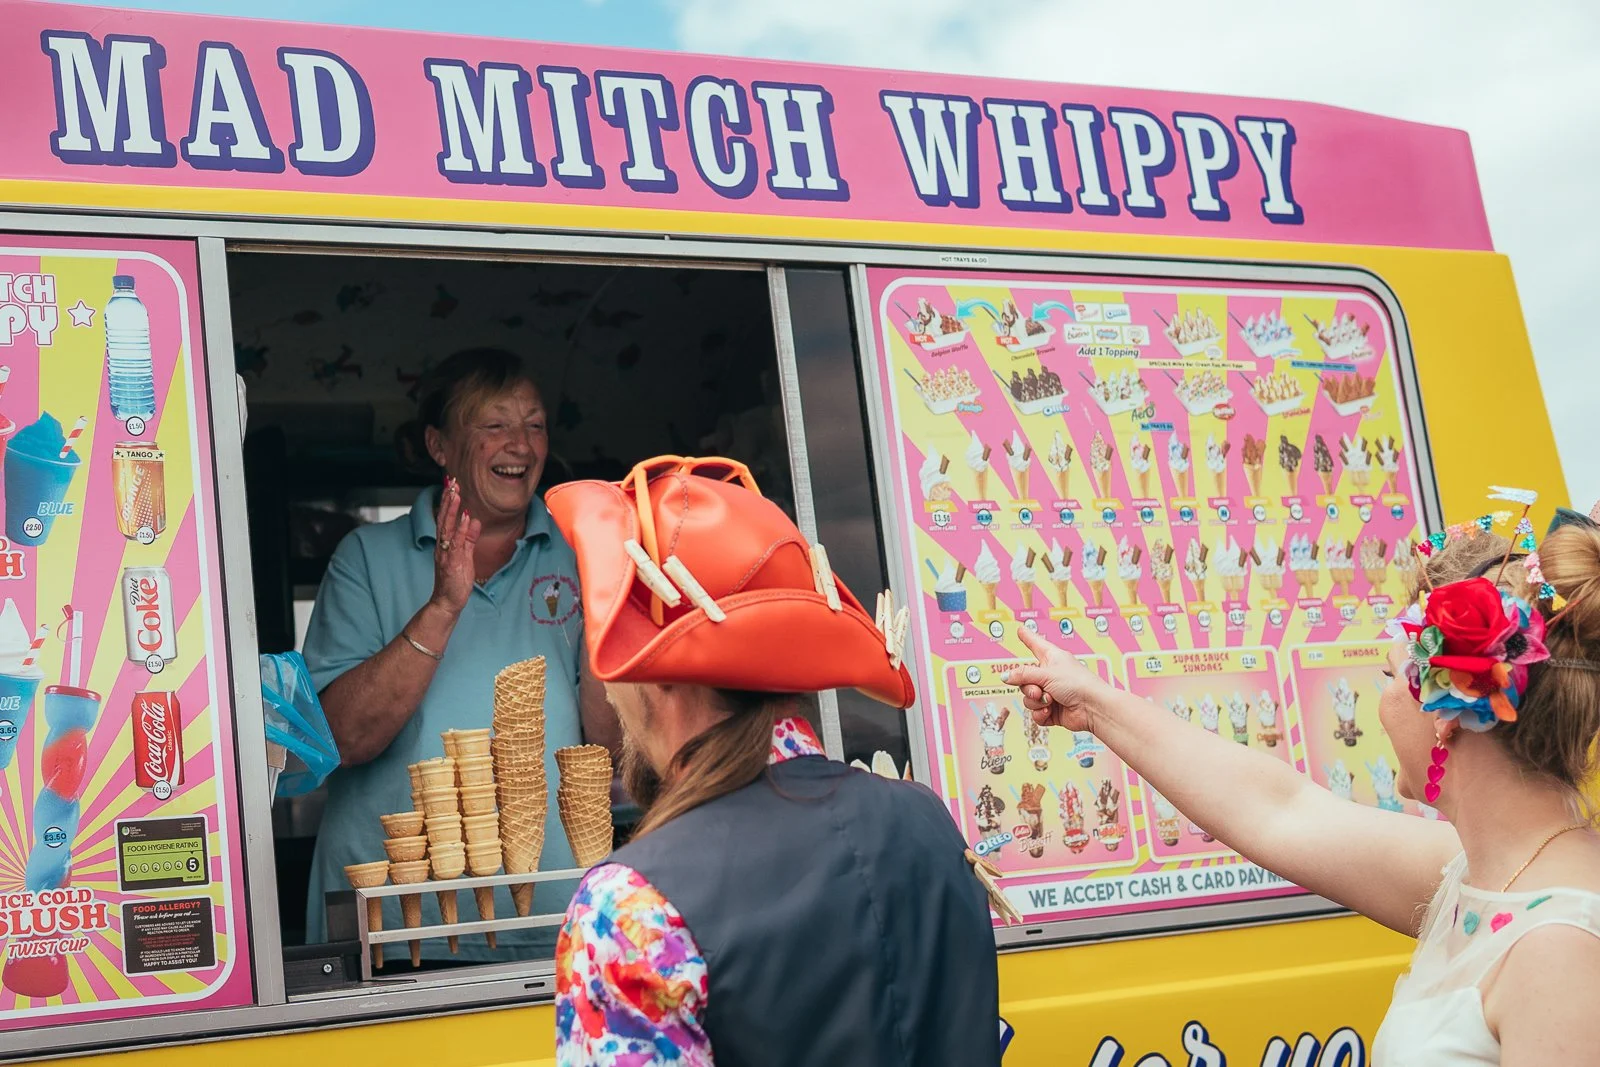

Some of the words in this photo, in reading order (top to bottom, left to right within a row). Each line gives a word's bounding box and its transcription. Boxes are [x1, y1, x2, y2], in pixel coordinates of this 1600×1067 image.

[41, 31, 374, 175] MAD
[425, 58, 849, 200] MITCH
[881, 90, 1303, 224] WHIPPY
[1078, 347, 1097, 356] Add
[1105, 347, 1139, 358] Topping
[129, 422, 142, 430] £1.50
[122, 465, 146, 521] ORANGE
[38, 502, 74, 516] BLUE
[25, 523, 42, 532] £2.50
[139, 531, 152, 539] £1.50
[130, 578, 140, 606] Diet
[136, 576, 163, 652] Coke
[1173, 654, 1200, 664] SUPER
[1202, 653, 1230, 662] SAUCE
[1342, 648, 1379, 657] SUNDAES
[148, 660, 162, 668] £1.50
[1183, 663, 1223, 673] SUNDAES
[980, 754, 1012, 769] bueno
[155, 786, 170, 794] £1.50
[44, 833, 67, 842] £3.50
[148, 843, 175, 851] HYGIENE
[176, 841, 198, 849] RATING
[974, 832, 1013, 856] OREO
[189, 859, 196, 871] 5
[1028, 888, 1058, 909] WE
[1063, 881, 1124, 905] ACCEPT
[1129, 877, 1172, 898] CASH
[1177, 875, 1188, 892] &
[1192, 871, 1235, 891] CARD
[1239, 866, 1284, 886] PAYM
[0, 894, 34, 909] ICE
[39, 889, 92, 905] COLD
[133, 905, 156, 913] FOOD
[159, 901, 201, 911] ALLERGY?
[9, 941, 57, 956] TWIST
[59, 939, 89, 953] CUP
